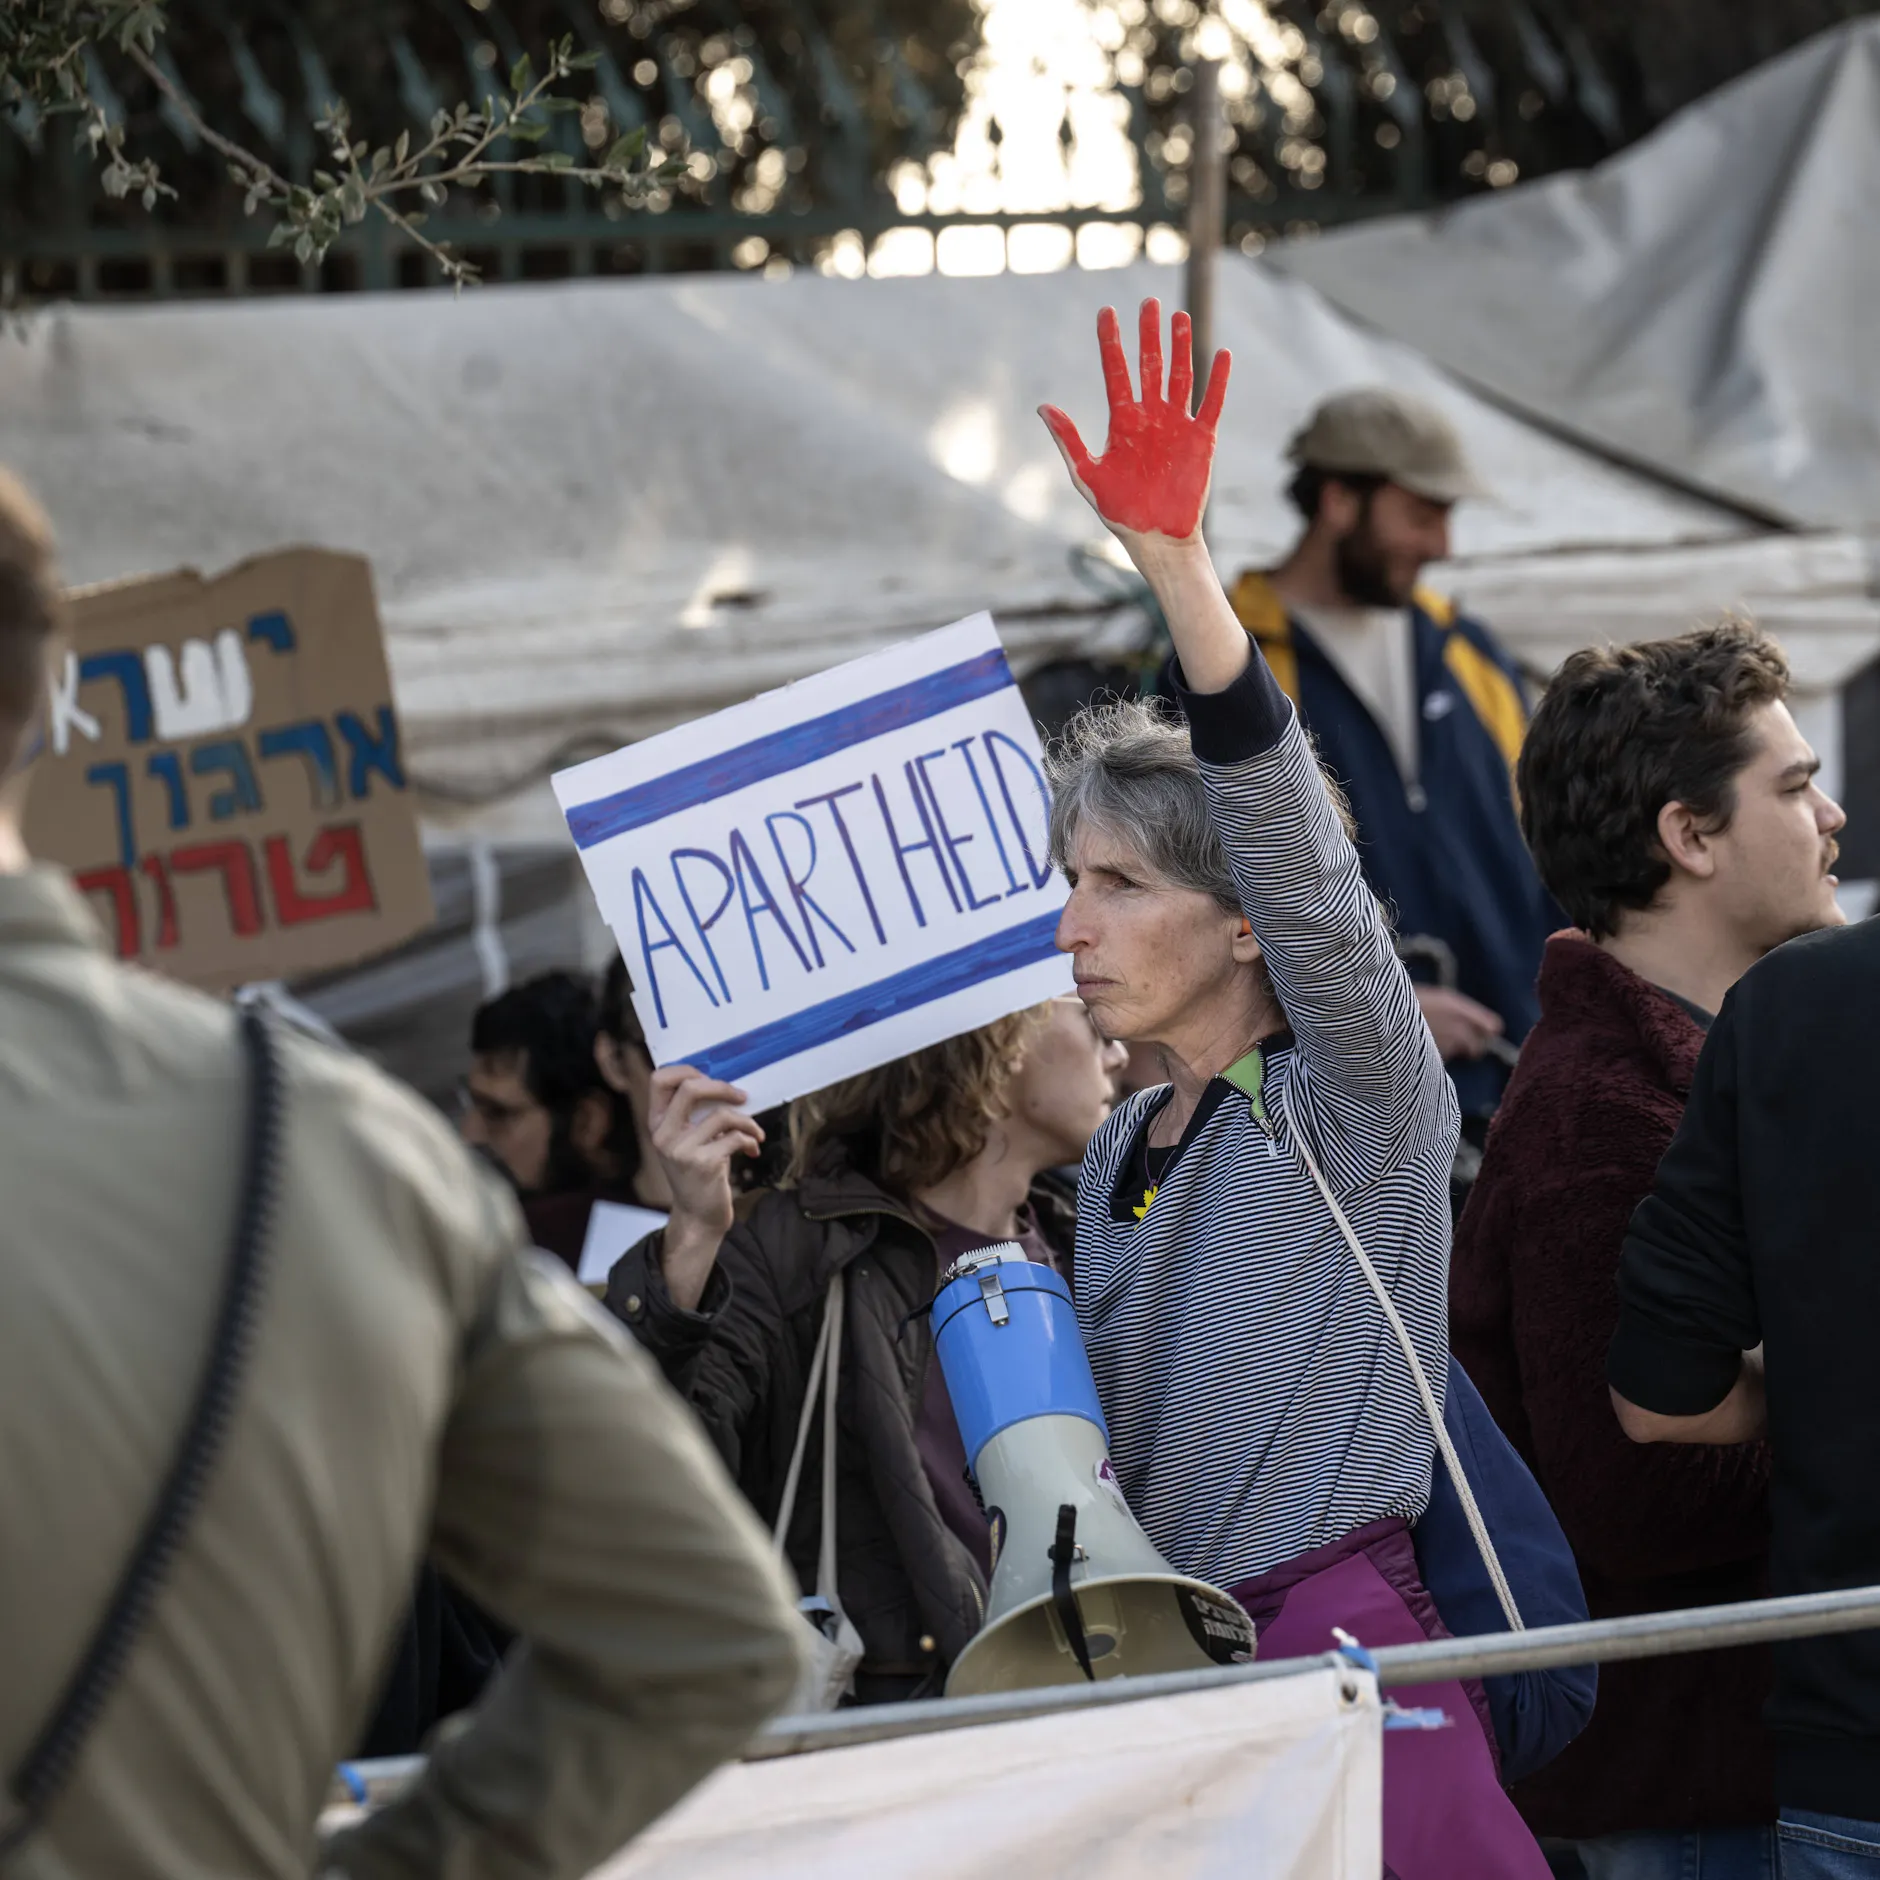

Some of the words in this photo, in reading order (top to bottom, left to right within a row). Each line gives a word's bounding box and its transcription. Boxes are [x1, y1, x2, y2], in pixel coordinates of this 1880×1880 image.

[26, 611, 295, 755] ישרא
[87, 706, 405, 868] ארגון
[74, 824, 378, 958] טרור
[631, 730, 1053, 1028] APARTHEID
